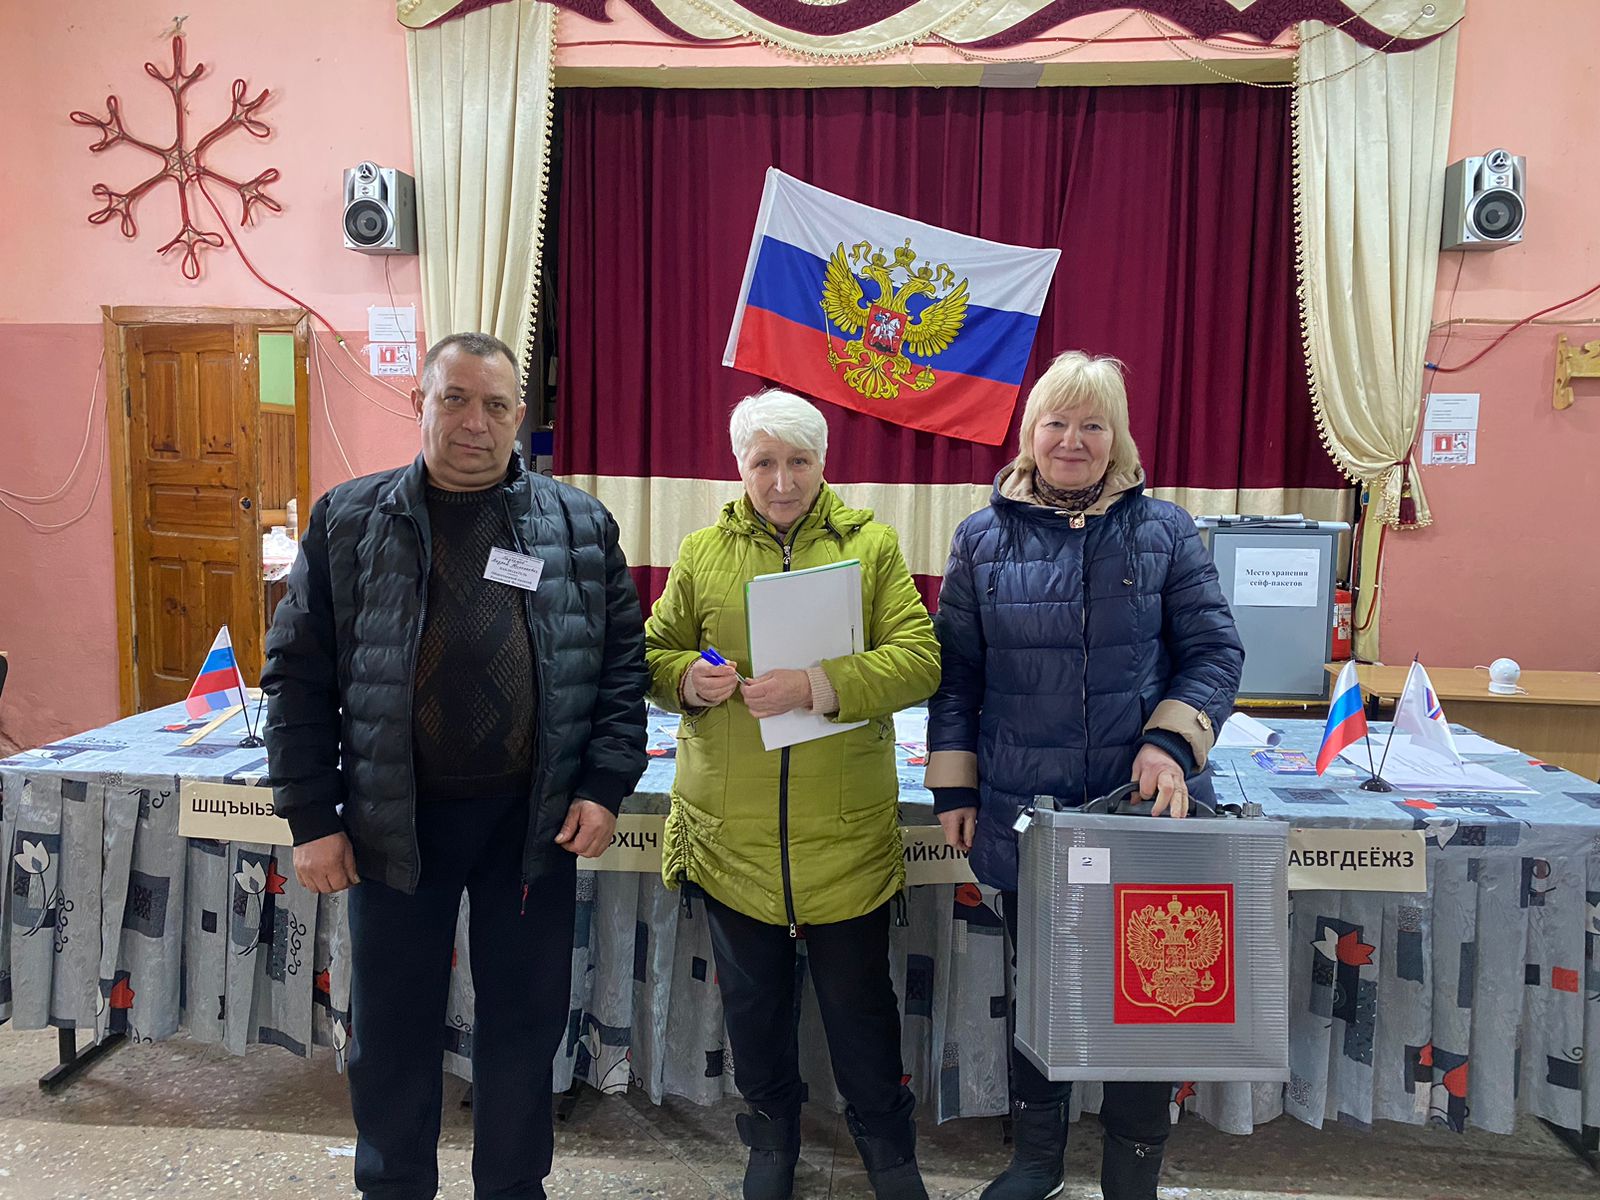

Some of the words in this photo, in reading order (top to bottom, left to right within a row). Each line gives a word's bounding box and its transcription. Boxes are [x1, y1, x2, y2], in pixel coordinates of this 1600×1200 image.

[1245, 568, 1270, 577] Место
[1271, 570, 1309, 578] хранения
[1249, 579, 1303, 588] сейф-пакетов
[1081, 856, 1093, 867] 2
[1287, 846, 1415, 871] АБВГДЕЁЖЗ
